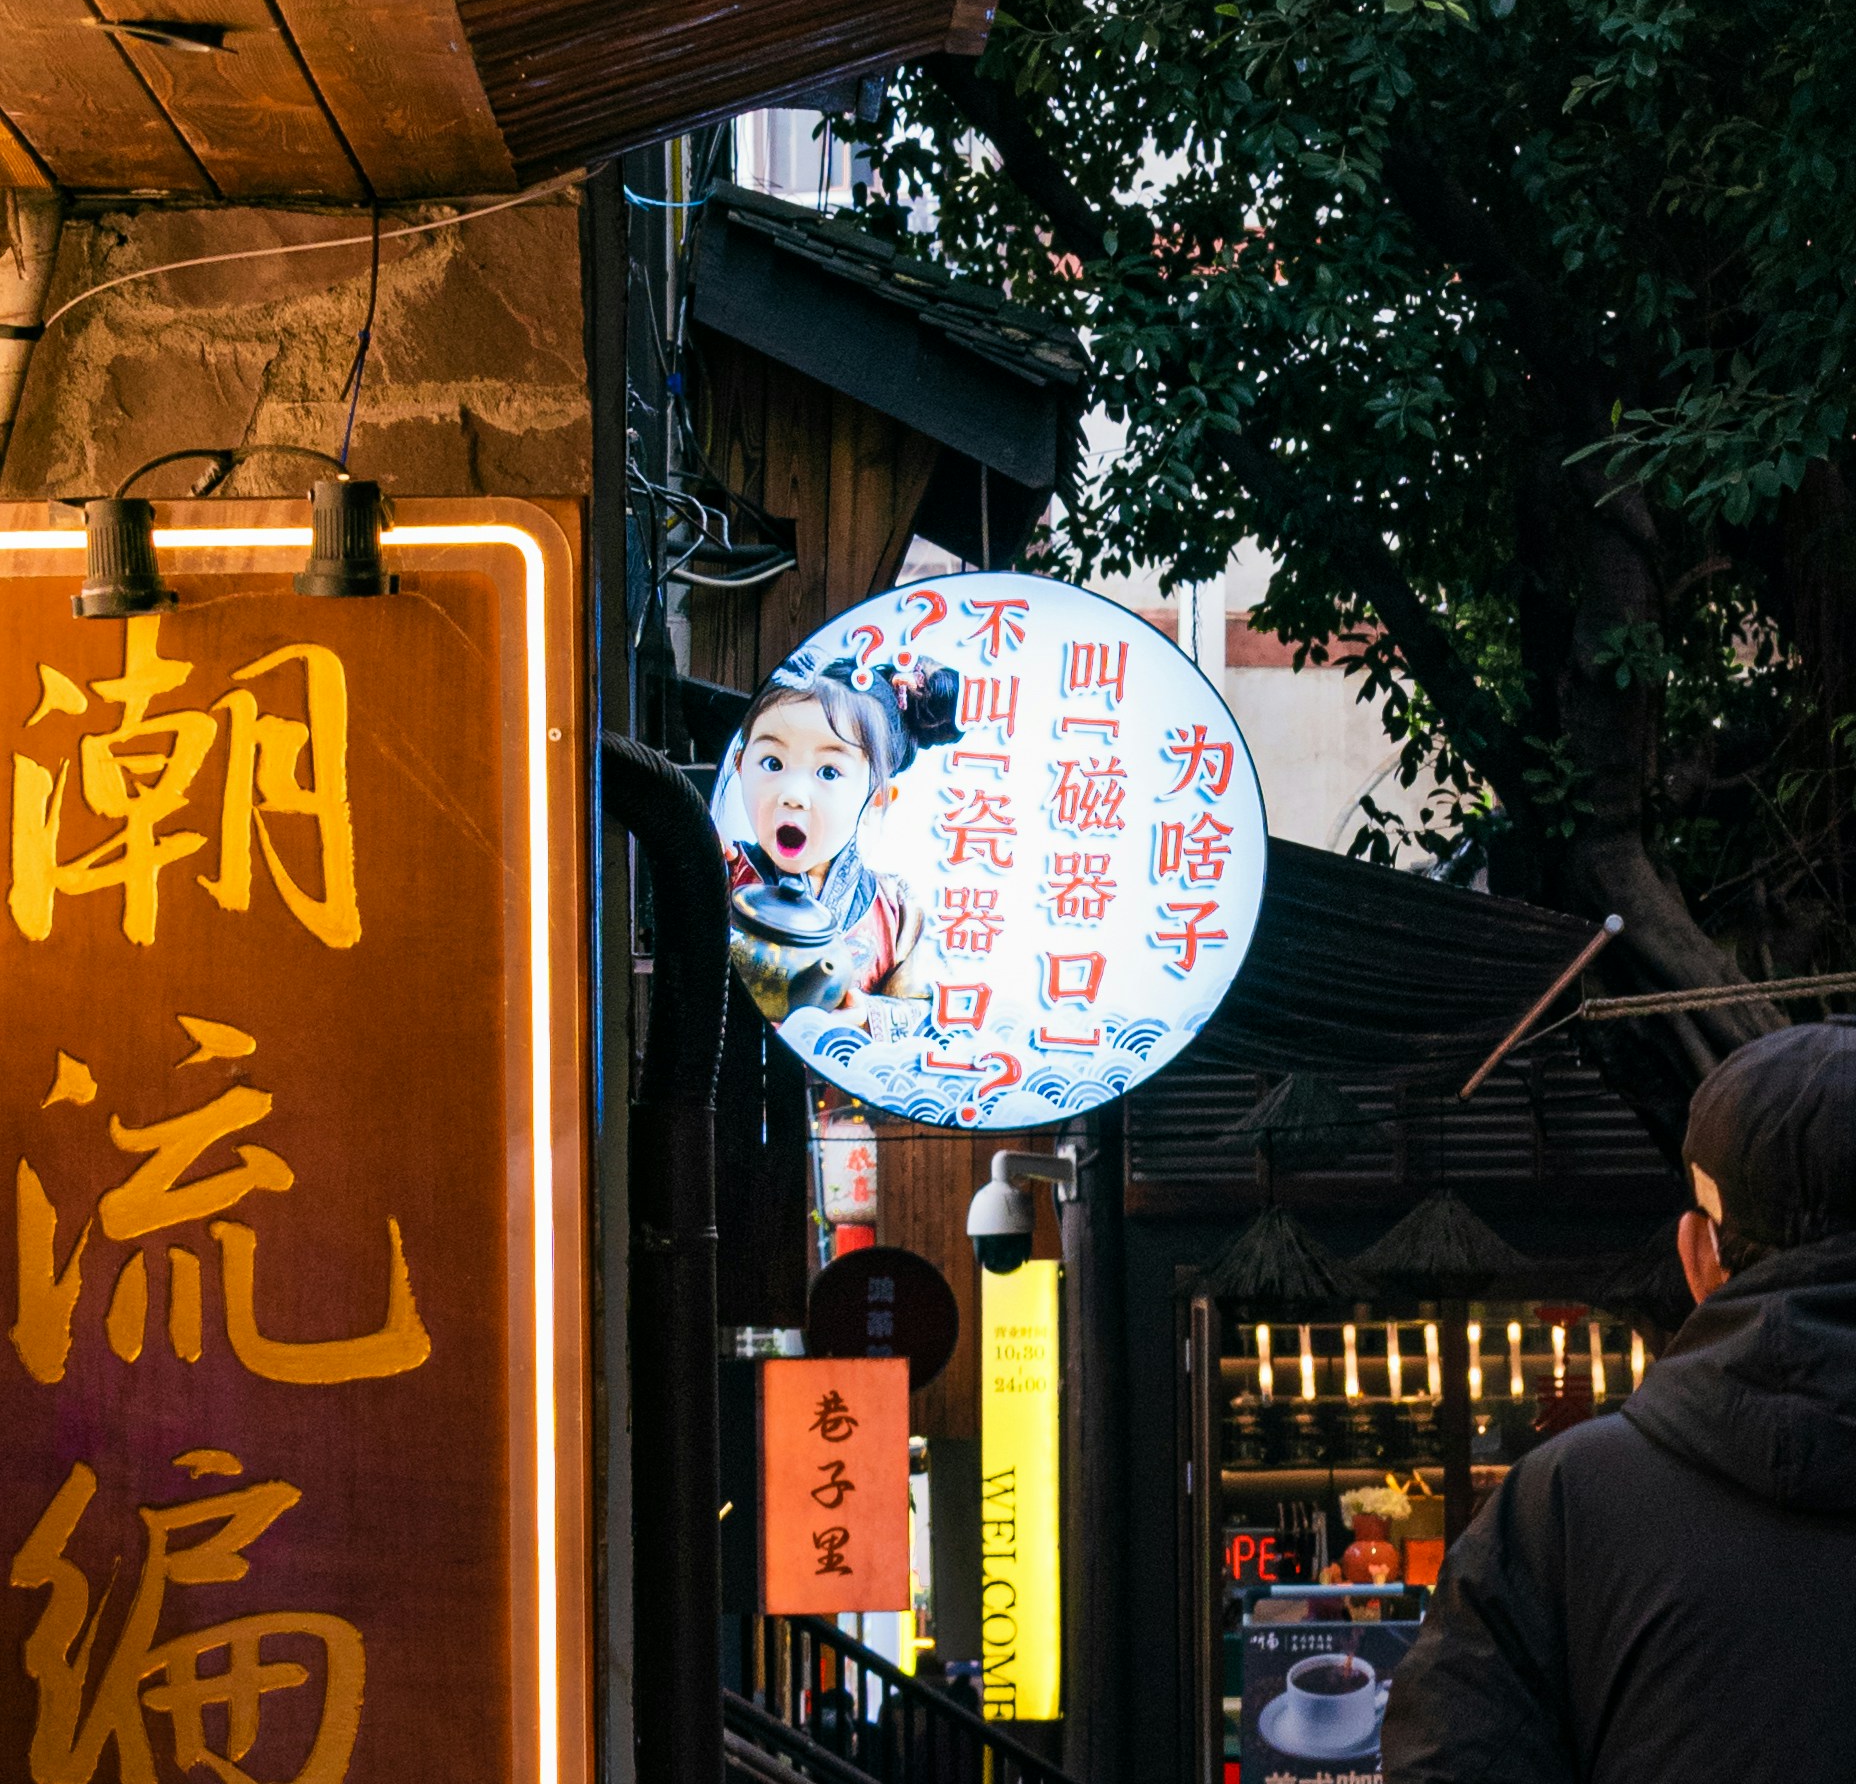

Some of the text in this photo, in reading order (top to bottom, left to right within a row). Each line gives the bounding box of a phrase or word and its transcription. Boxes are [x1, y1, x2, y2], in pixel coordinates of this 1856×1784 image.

[1156, 723, 1234, 972] 为啥子
[808, 1389, 859, 1576] 巷子里
[994, 1376, 1047, 1393] 24:00
[982, 1465, 1016, 1721] WELCOME
